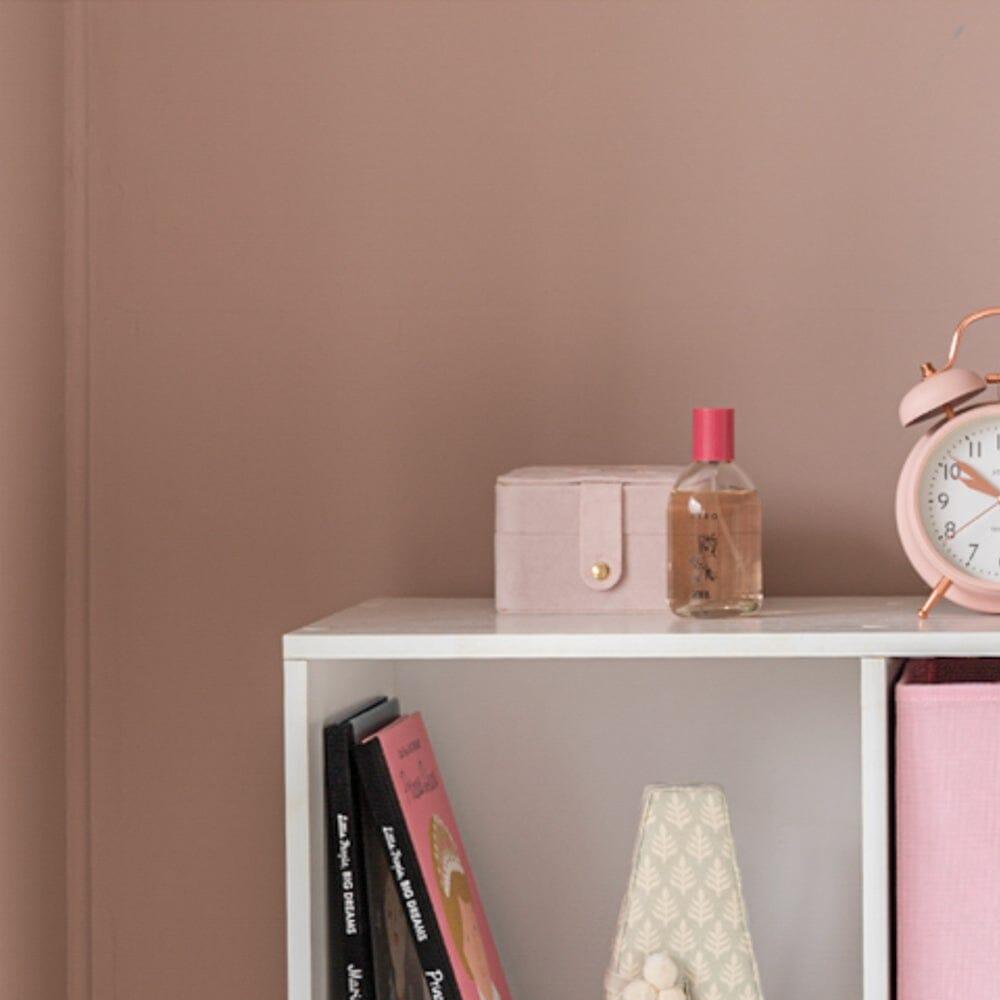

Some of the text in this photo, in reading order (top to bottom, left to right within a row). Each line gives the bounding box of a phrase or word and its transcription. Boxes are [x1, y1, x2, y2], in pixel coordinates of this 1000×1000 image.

[969, 441, 981, 458] 11
[944, 463, 961, 480] 10
[938, 492, 950, 510] 9
[944, 521, 956, 538] 8
[969, 544, 979, 562] 7
[342, 871, 354, 889] BIG
[399, 879, 415, 900] BIG
[343, 892, 357, 935] DREAMS
[406, 900, 428, 942] DREAMS
